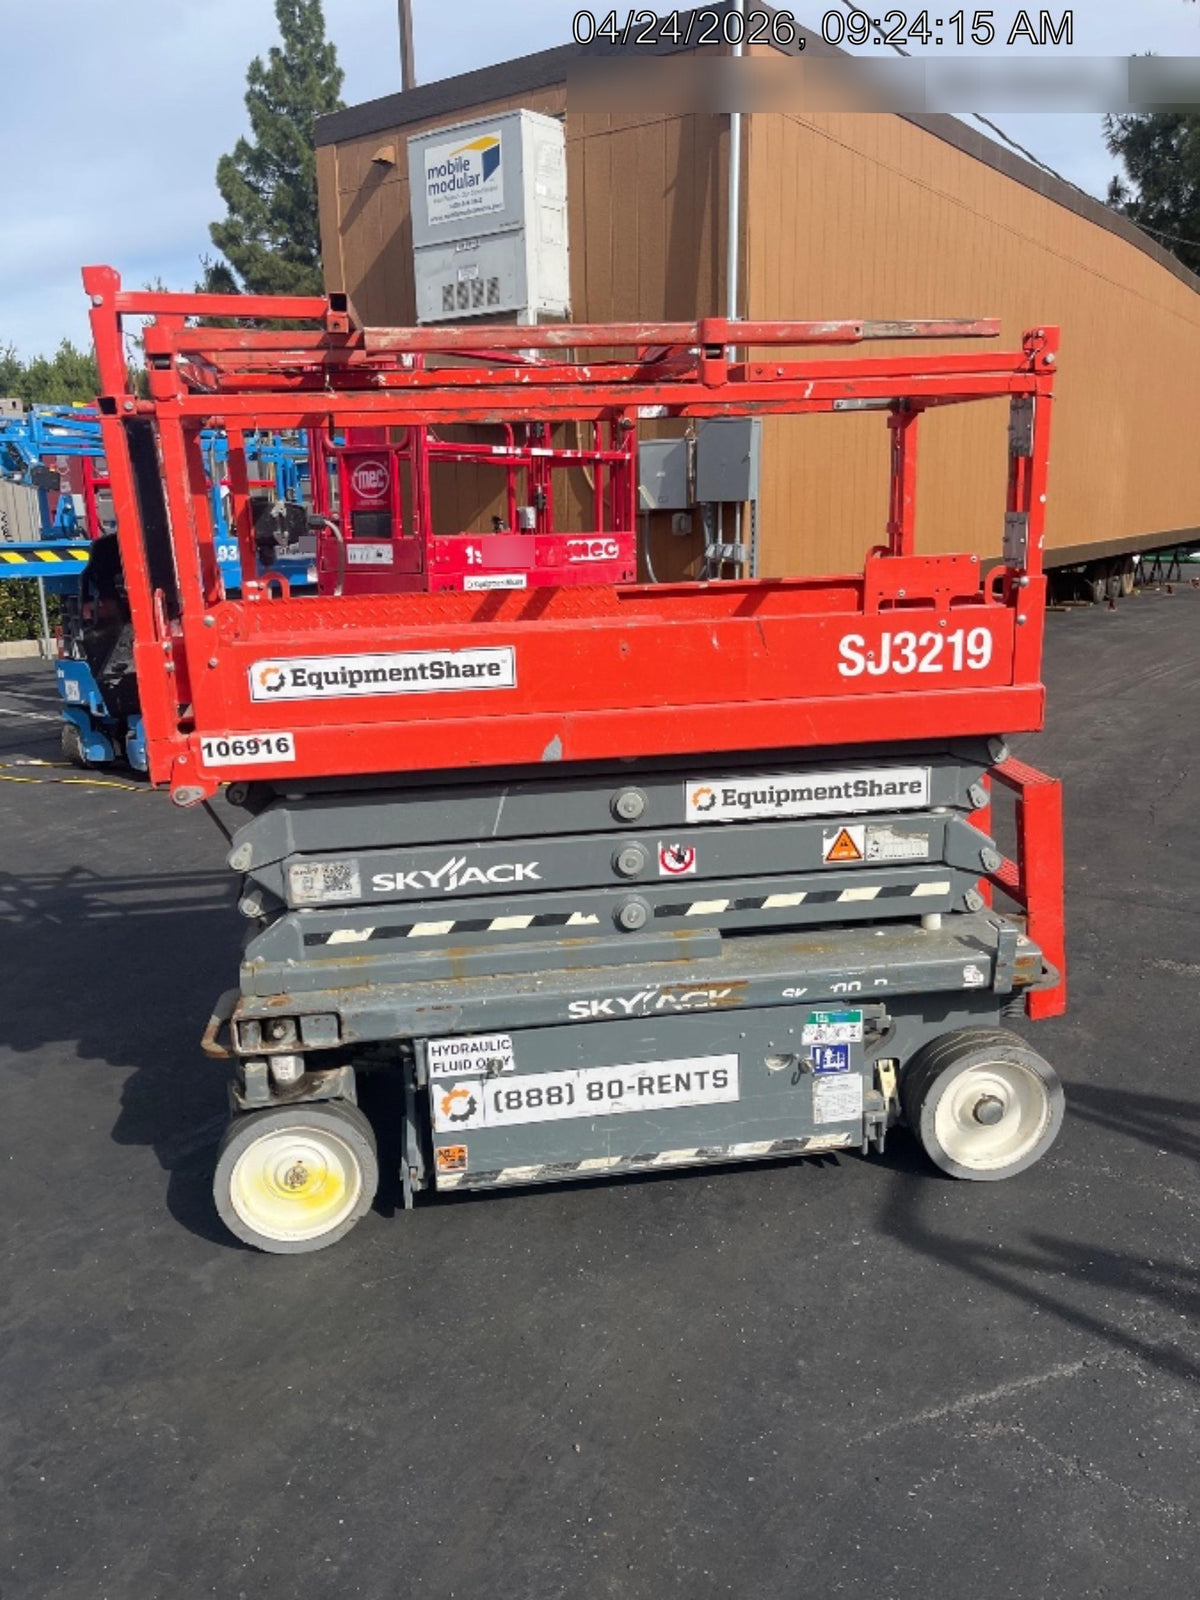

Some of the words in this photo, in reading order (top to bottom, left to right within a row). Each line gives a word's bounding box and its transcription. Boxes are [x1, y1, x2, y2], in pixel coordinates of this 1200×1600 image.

[428, 156, 470, 180] mobile
[428, 173, 481, 196] modular
[837, 627, 992, 676] SJ3219
[290, 659, 501, 690] EquipmentShare
[202, 737, 290, 759] 106916
[721, 779, 922, 808] EquipmentShare
[372, 856, 543, 892] SKYJACK
[431, 1039, 511, 1057] HYDRAULIC
[433, 1059, 472, 1073] FLUID
[476, 1055, 511, 1070] OY
[494, 1082, 575, 1113] (888)
[586, 1068, 729, 1102] 80-RENTS
